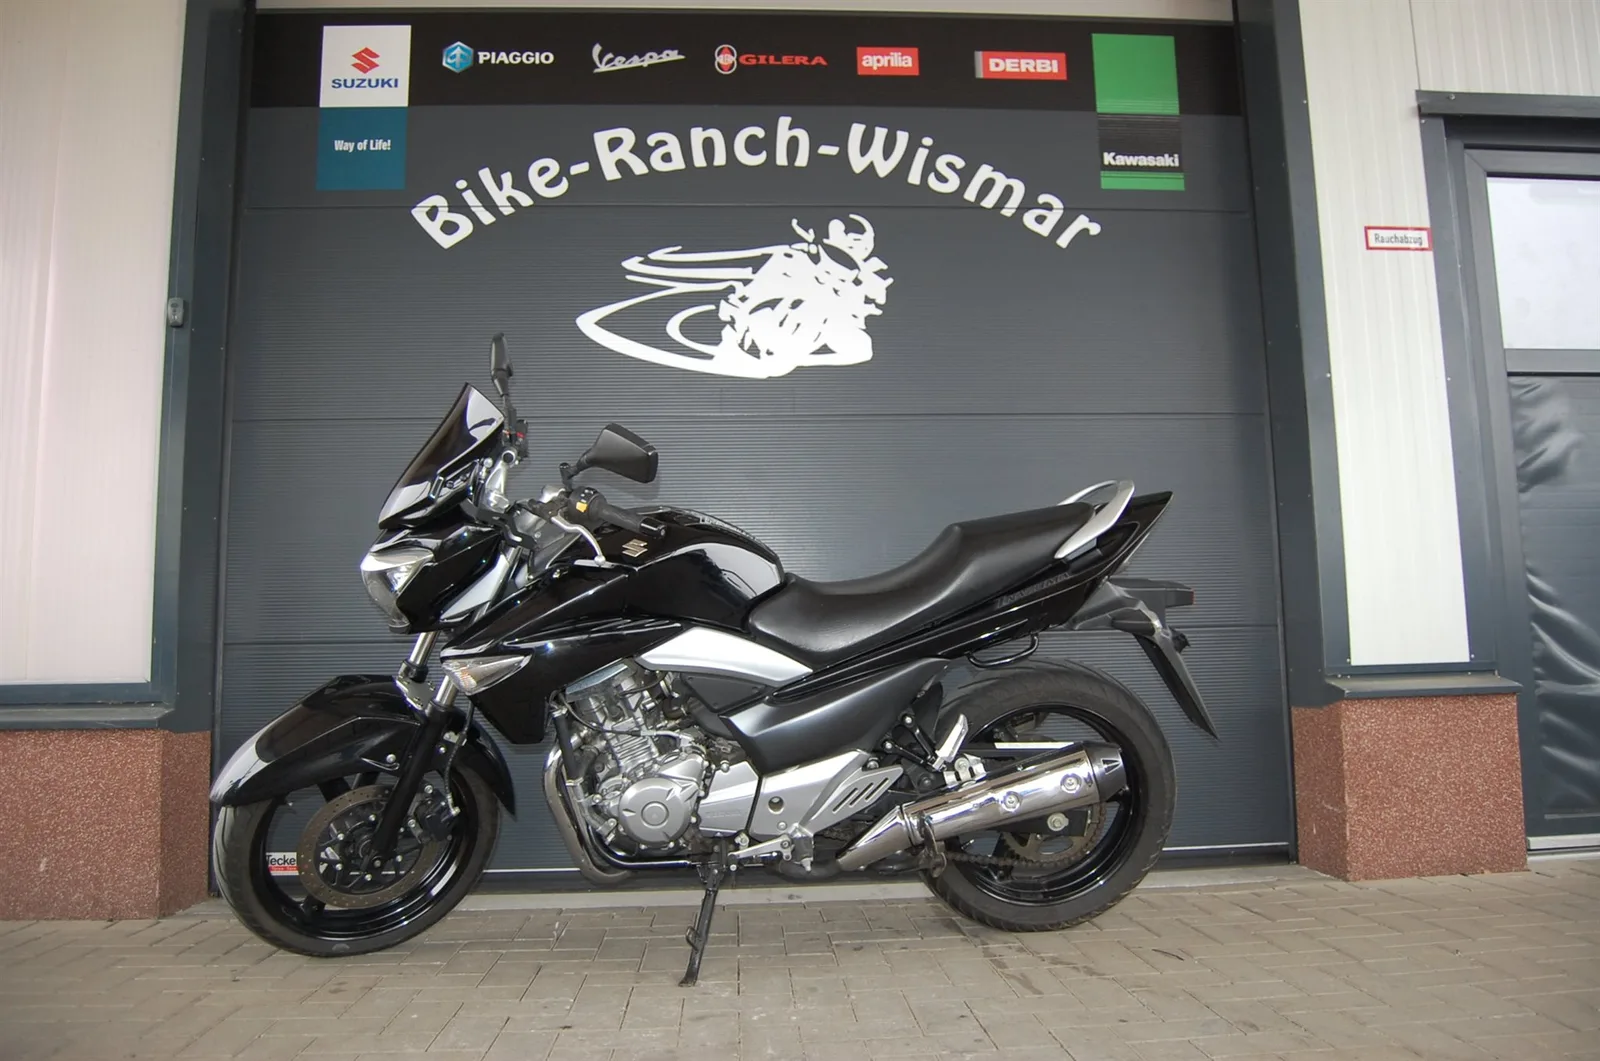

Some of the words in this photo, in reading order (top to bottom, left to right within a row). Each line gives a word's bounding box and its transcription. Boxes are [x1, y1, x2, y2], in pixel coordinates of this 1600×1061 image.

[477, 51, 555, 65] PIAGGIO
[591, 43, 686, 73] Vespa
[739, 53, 828, 66] GILERA
[861, 52, 913, 71] aprilia
[988, 57, 1059, 73] DERBI
[331, 78, 399, 89] SUZUKI
[334, 139, 355, 153] Way
[356, 139, 368, 151] of
[369, 139, 391, 151] Life!
[1102, 151, 1180, 168] Kawasaki
[411, 116, 1101, 249] Bike-Ranch-Wismar
[1374, 233, 1423, 246] Rauchabzug
